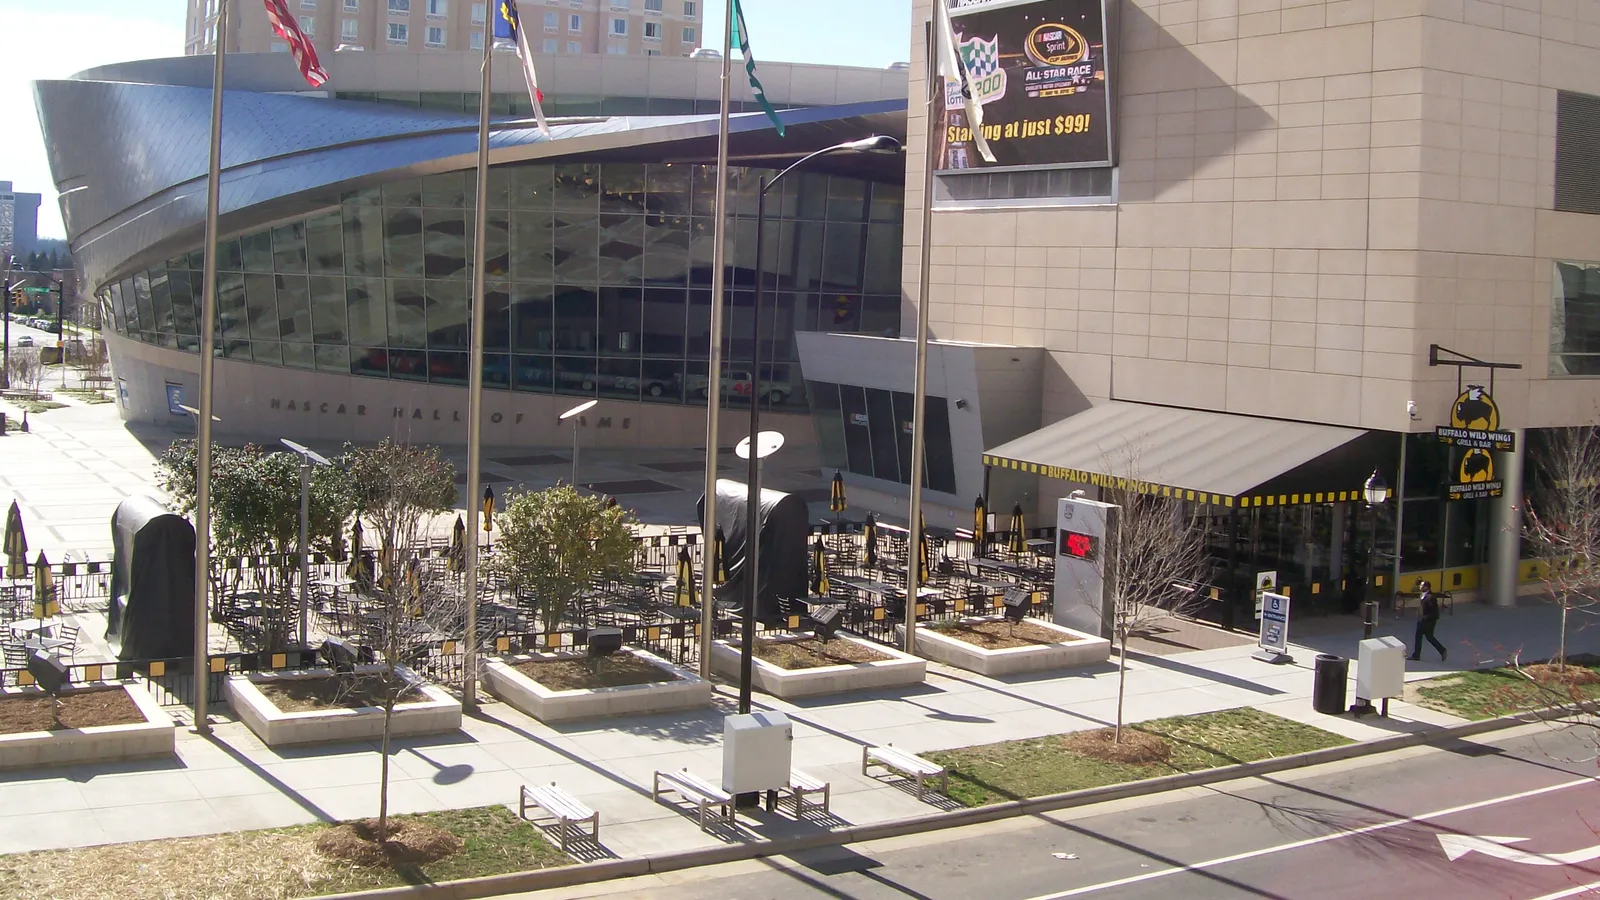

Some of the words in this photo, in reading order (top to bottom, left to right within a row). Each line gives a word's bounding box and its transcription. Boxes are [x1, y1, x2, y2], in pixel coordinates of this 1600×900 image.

[1046, 42, 1066, 53] Sprint
[1067, 65, 1092, 76] RACE
[947, 123, 1002, 143] Staring
[1004, 122, 1020, 138] at
[1022, 118, 1051, 138] just
[1054, 113, 1090, 136] $99!
[614, 376, 636, 390] 22
[732, 380, 753, 395] 42
[270, 398, 367, 416] NASCAR
[392, 406, 461, 422] HALL
[491, 411, 524, 424] OF
[1438, 428, 1468, 438] BUFFALO
[1469, 430, 1487, 440] WILD
[1488, 432, 1512, 442] WINGS
[1456, 438, 1472, 446] GRILL
[1048, 465, 1088, 484] BUFFALO
[1090, 472, 1114, 489] WILD
[1117, 478, 1149, 495] WINGS
[1449, 484, 1472, 493] BUFFALO
[1472, 483, 1486, 491] WILD
